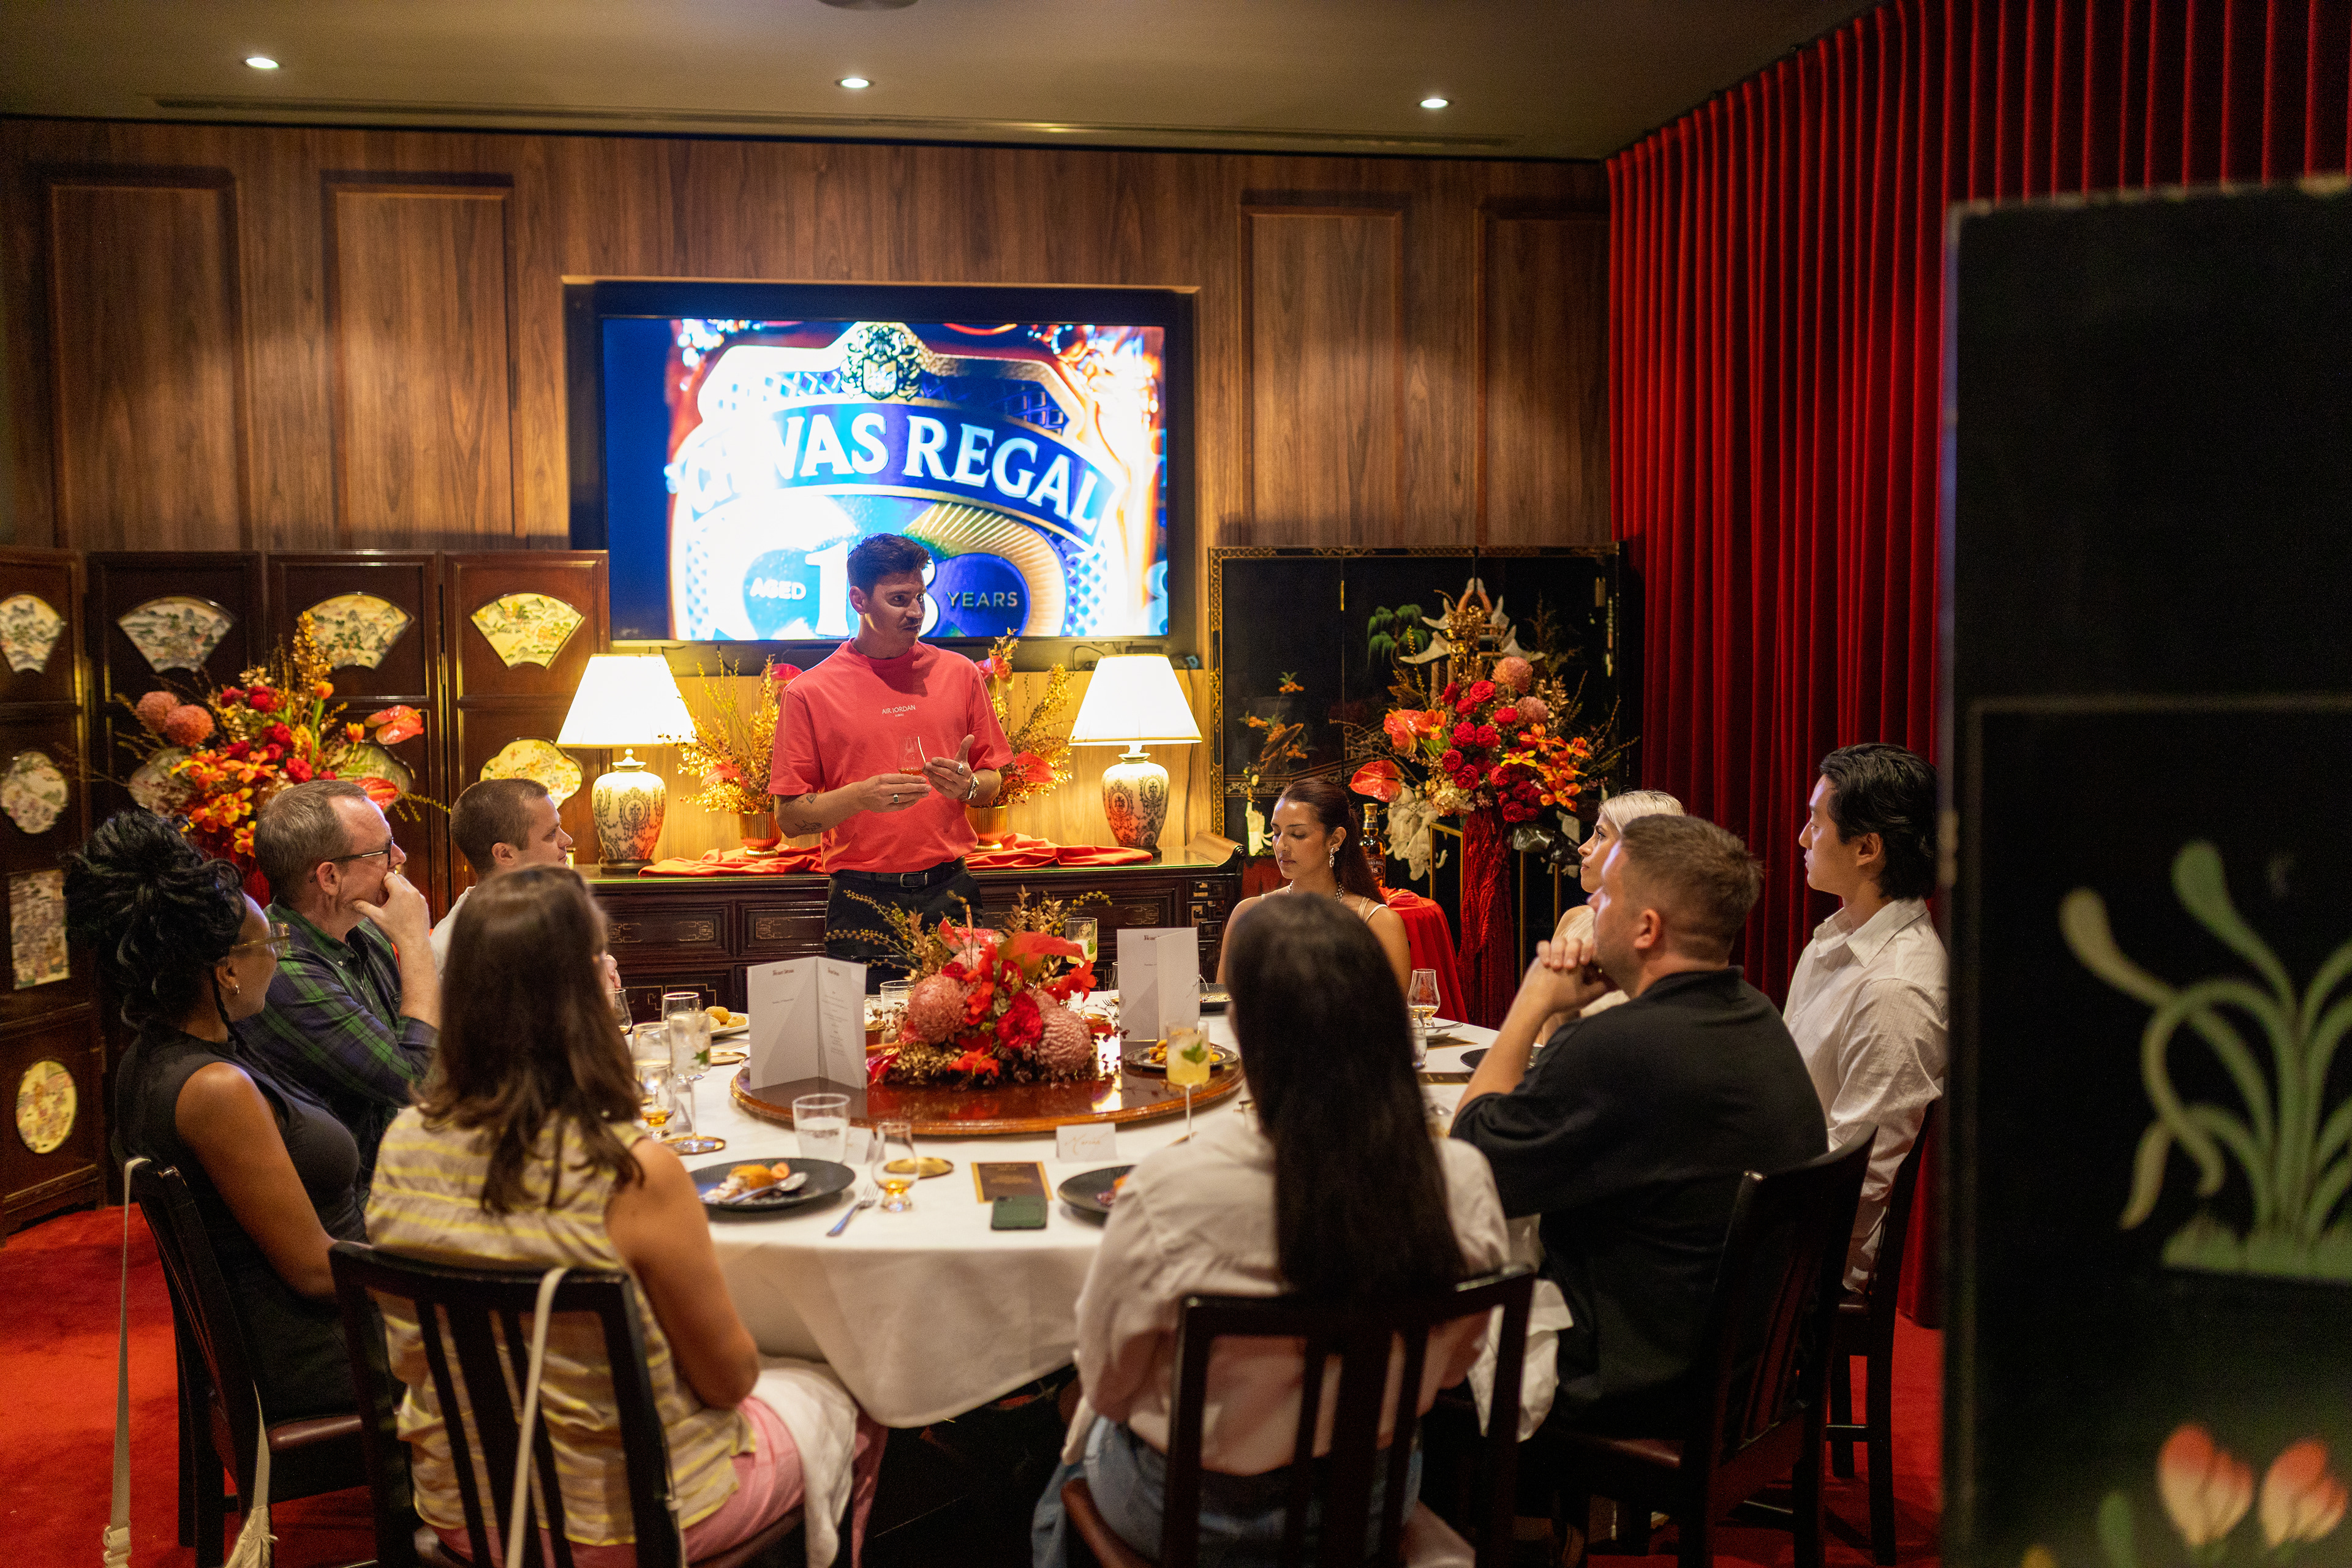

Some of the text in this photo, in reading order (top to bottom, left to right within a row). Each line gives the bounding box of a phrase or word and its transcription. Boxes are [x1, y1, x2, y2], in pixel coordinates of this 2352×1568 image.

[902, 415, 1098, 536] REGAL
[749, 577, 807, 600] AGED
[946, 591, 1018, 608] YEARS
[892, 704, 916, 714] JORDAN
